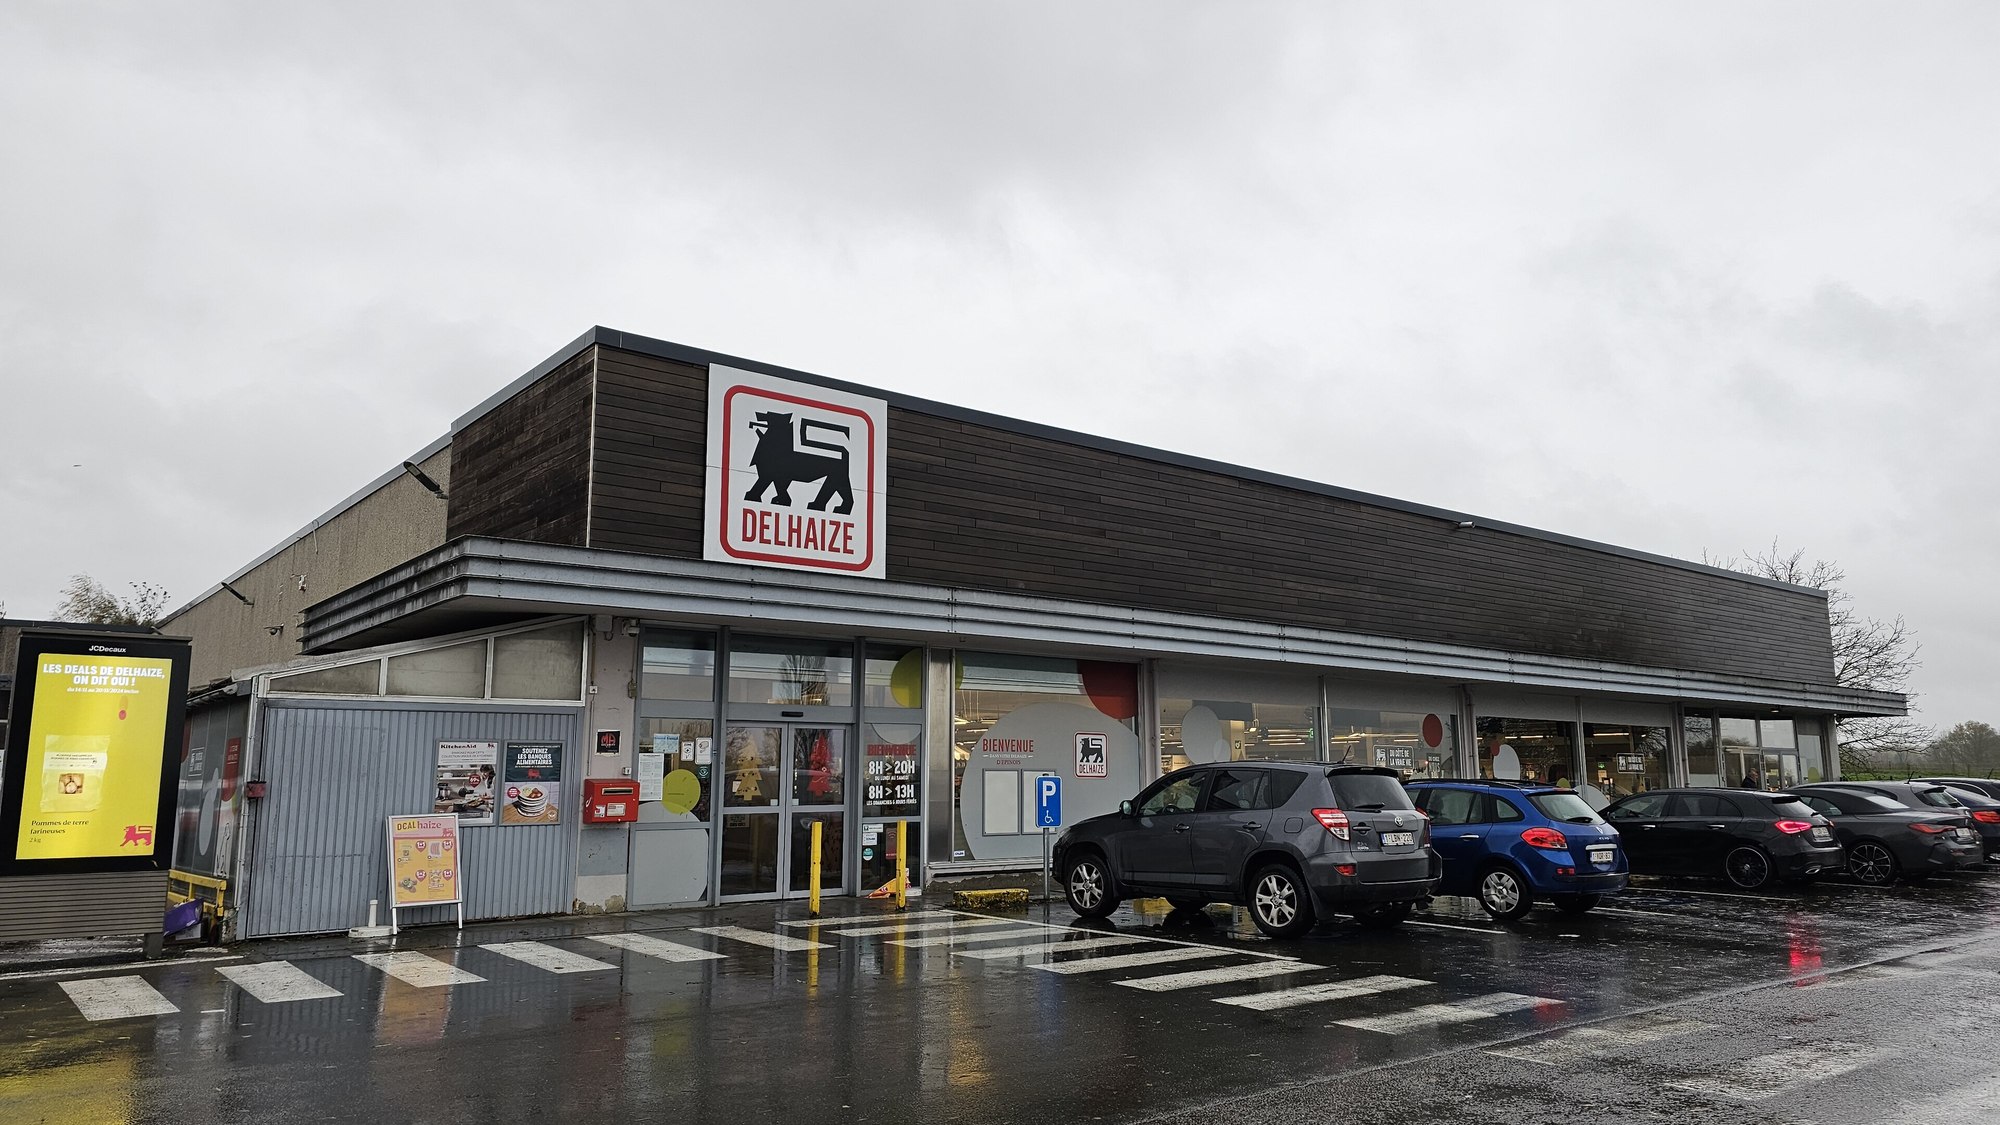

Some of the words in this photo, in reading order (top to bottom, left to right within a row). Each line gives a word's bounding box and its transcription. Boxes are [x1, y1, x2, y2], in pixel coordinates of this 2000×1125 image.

[742, 508, 855, 554] DELHAIZE
[43, 664, 62, 673] LES
[65, 664, 97, 674] DEALS
[100, 666, 114, 675] DE
[116, 667, 165, 678] DELHAIZE,
[74, 676, 88, 685] ON
[91, 676, 109, 685] DIT
[111, 677, 128, 686] OUI
[983, 739, 1034, 752] BIENVENUE
[869, 761, 883, 774] 8H
[894, 760, 915, 774] 20H
[1080, 765, 1104, 773] DELHAIZE
[869, 785, 883, 799] 8H
[895, 784, 914, 798] 13H
[1042, 780, 1056, 806] P
